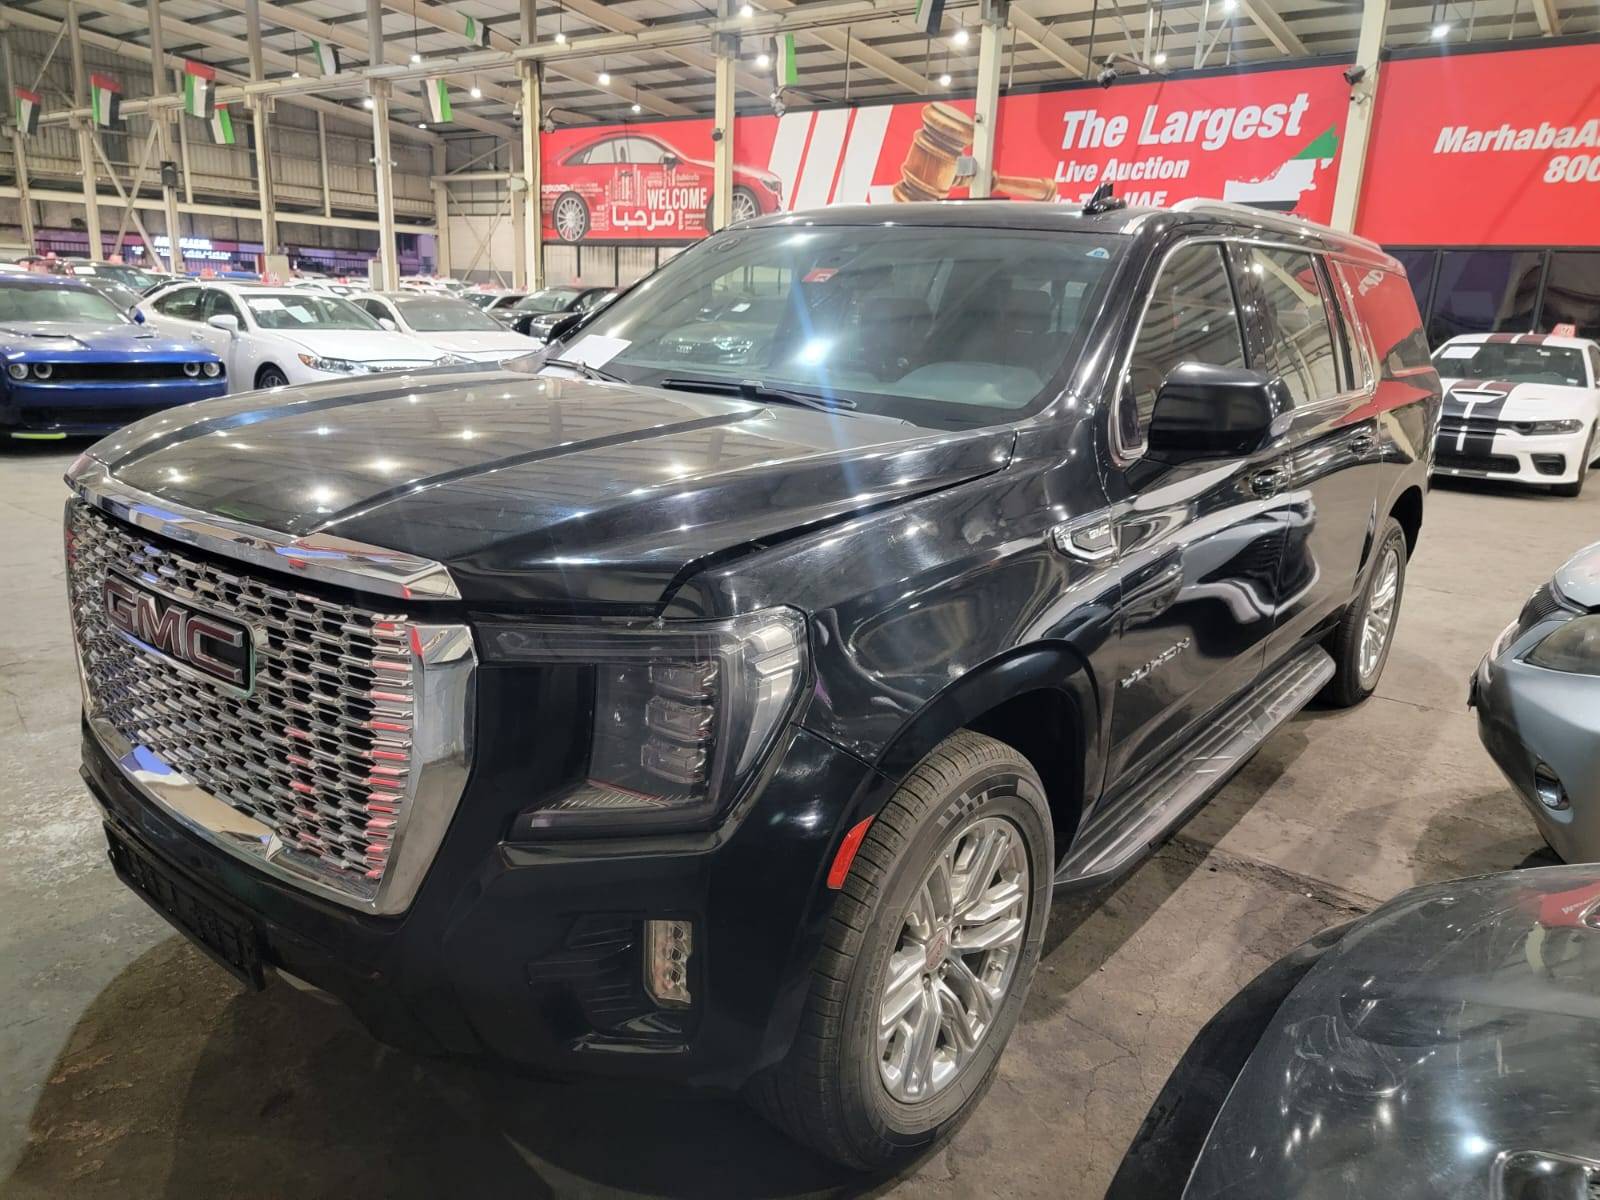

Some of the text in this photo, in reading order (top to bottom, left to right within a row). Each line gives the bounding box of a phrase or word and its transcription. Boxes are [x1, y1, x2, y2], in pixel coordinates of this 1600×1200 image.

[1061, 92, 1310, 151] The Largest
[1433, 119, 1600, 154] MarhabaA
[1055, 157, 1190, 183] Live Auction
[647, 187, 707, 210] WELCOME
[1124, 191, 1168, 209] UAE
[612, 205, 675, 231] مرحبا
[104, 575, 244, 684] GMC
